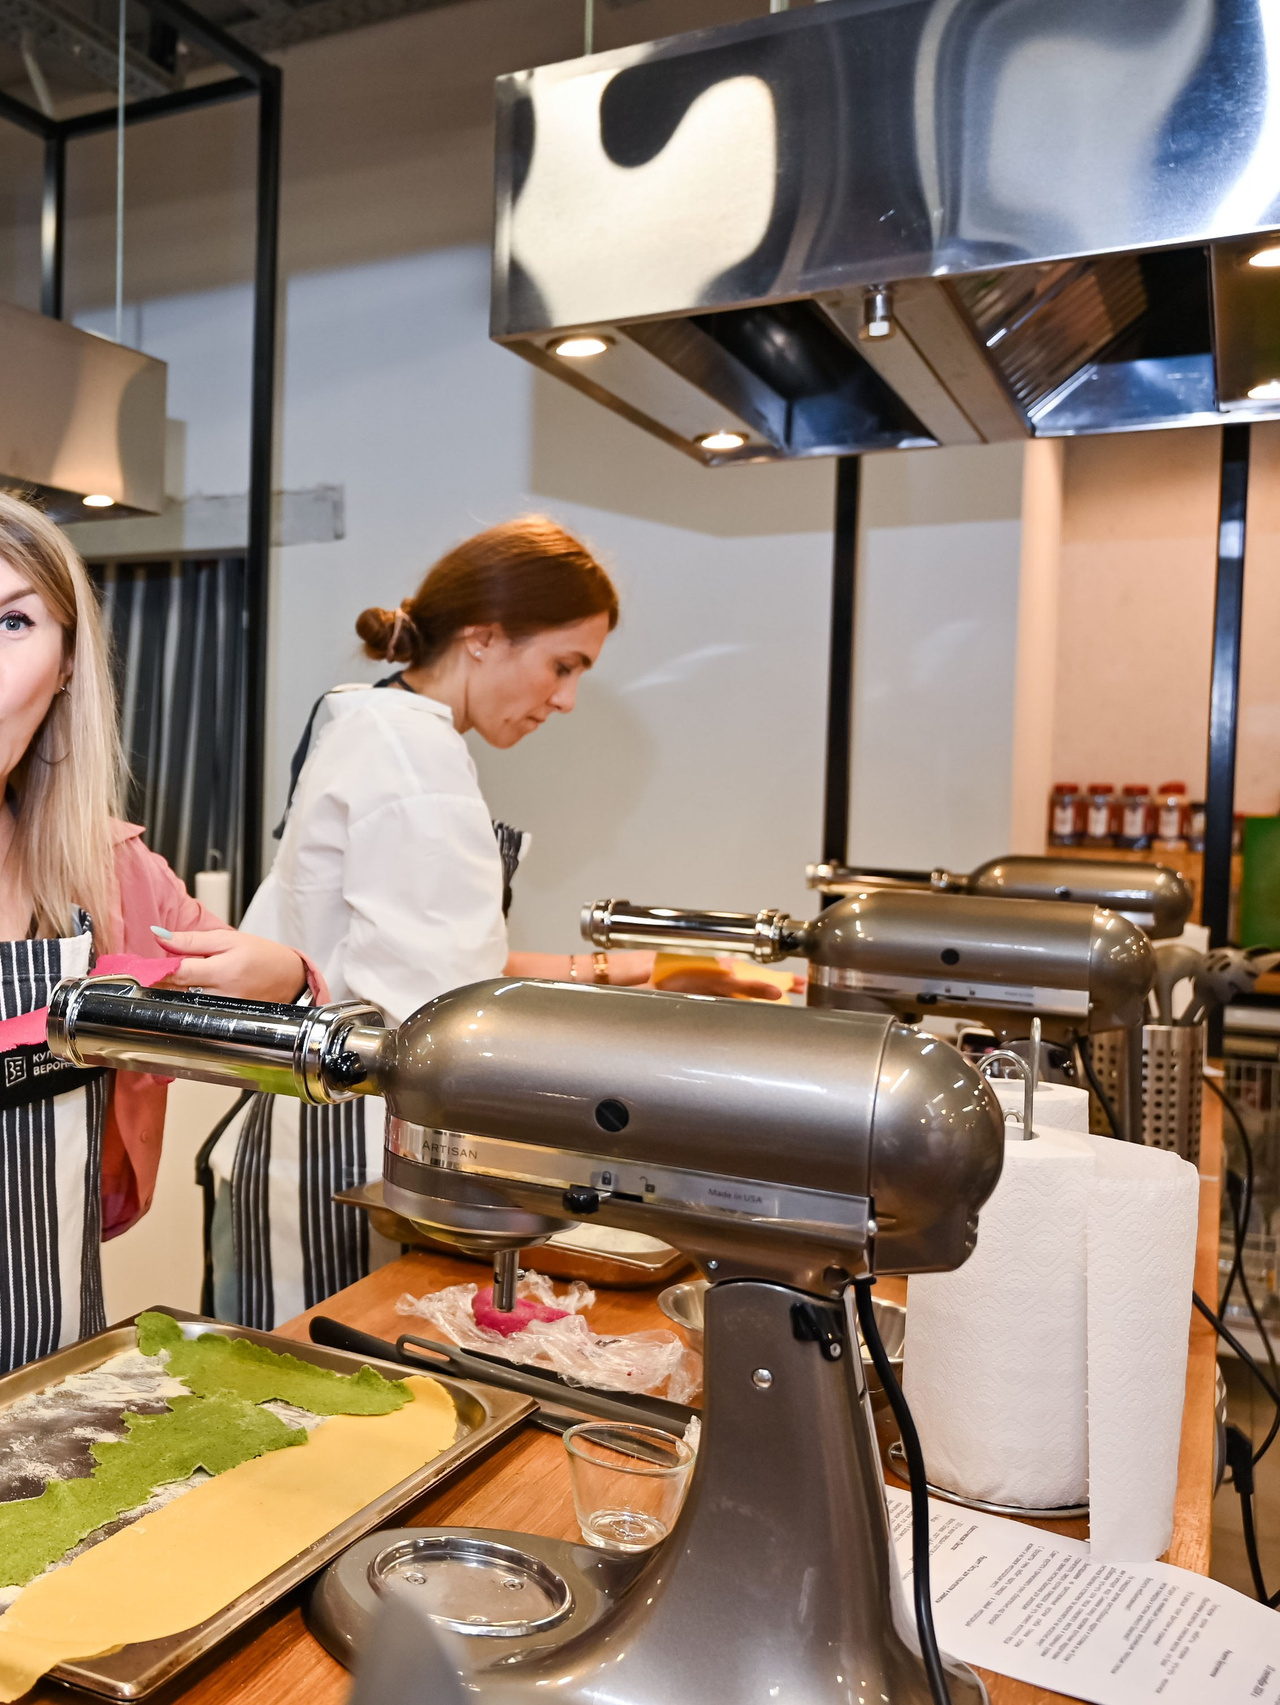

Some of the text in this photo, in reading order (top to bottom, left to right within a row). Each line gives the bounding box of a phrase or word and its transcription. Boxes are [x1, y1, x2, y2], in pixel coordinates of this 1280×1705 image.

[33, 1061, 69, 1076] ВЕРОН
[708, 1188, 762, 1204] Made in USA
